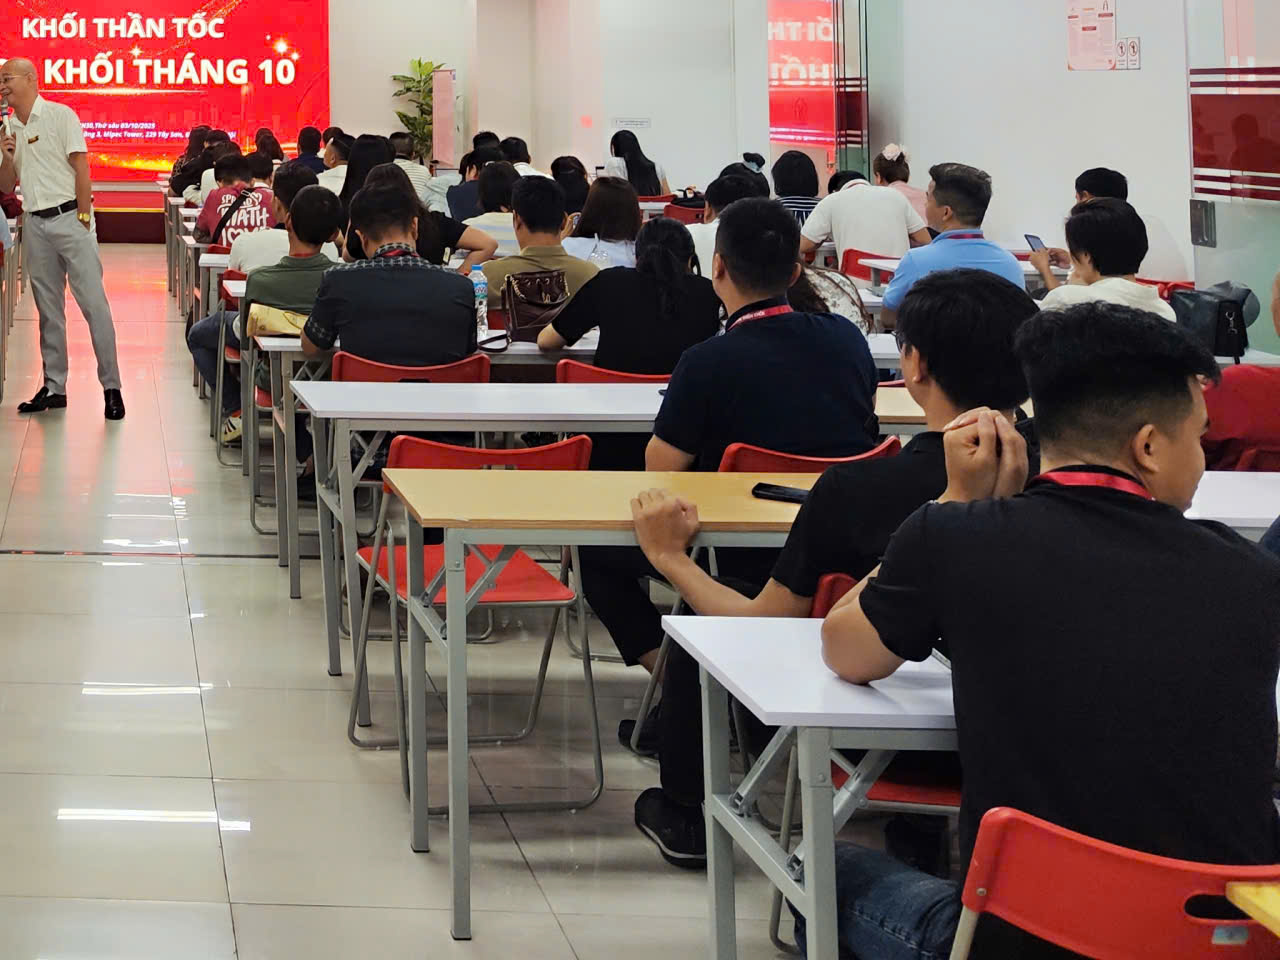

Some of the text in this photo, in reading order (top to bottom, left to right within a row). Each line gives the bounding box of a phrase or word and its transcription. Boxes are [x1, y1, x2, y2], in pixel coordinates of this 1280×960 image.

[22, 12, 225, 38] KHỐI THẦN TỐC
[44, 51, 124, 85] KHỐI
[132, 52, 249, 85] THÁNG
[258, 58, 296, 85] 10
